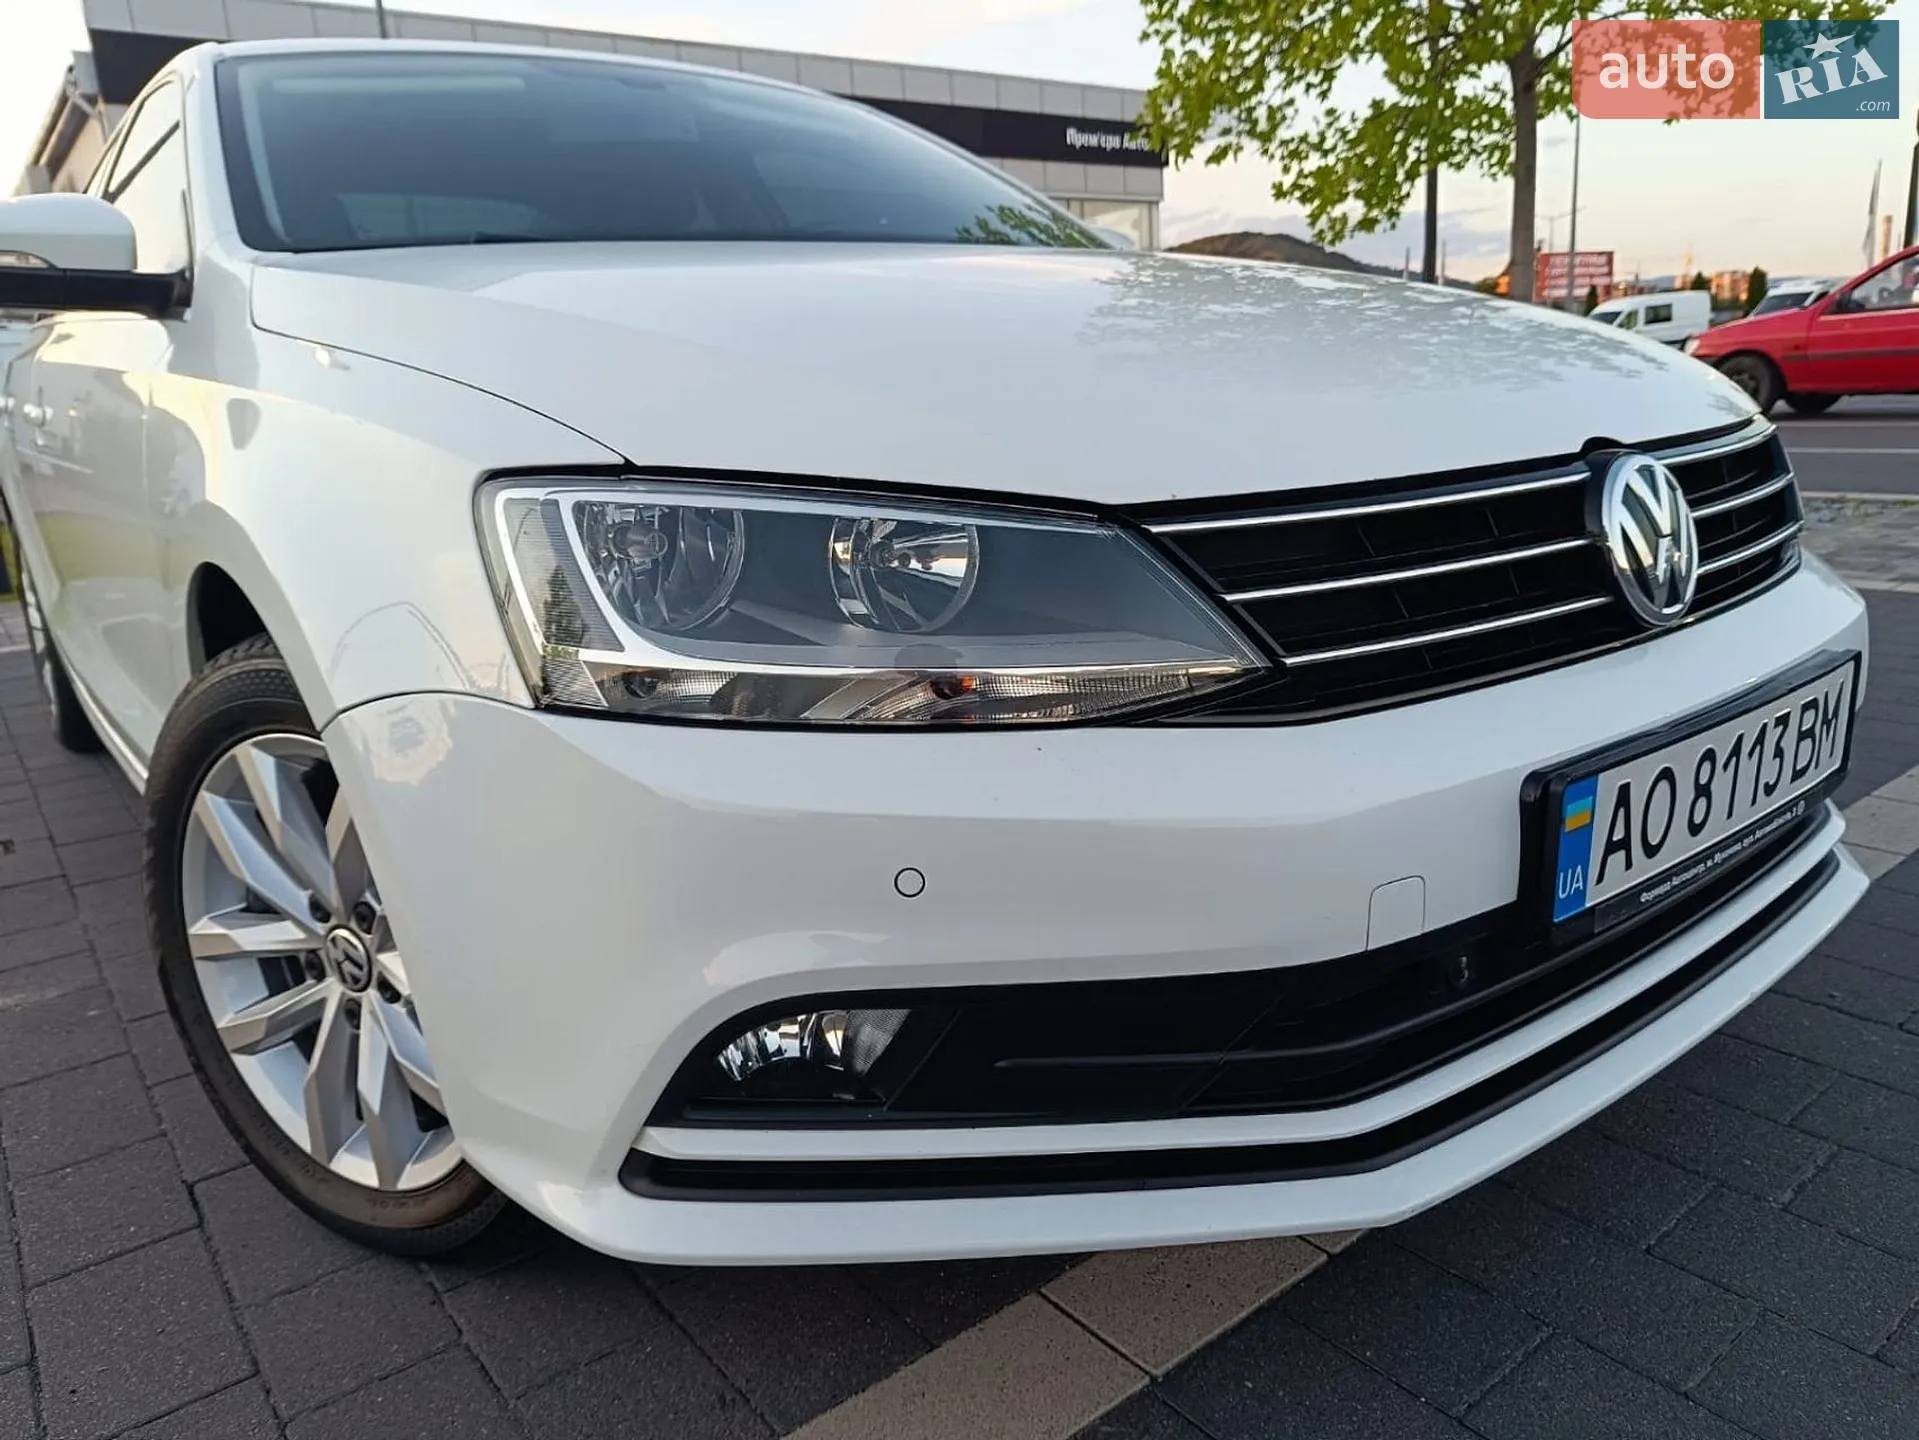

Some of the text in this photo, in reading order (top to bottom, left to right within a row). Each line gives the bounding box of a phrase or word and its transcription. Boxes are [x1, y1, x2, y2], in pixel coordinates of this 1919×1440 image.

[1594, 679, 1845, 887] AO 8113 BM
[1559, 864, 1583, 899] UA
